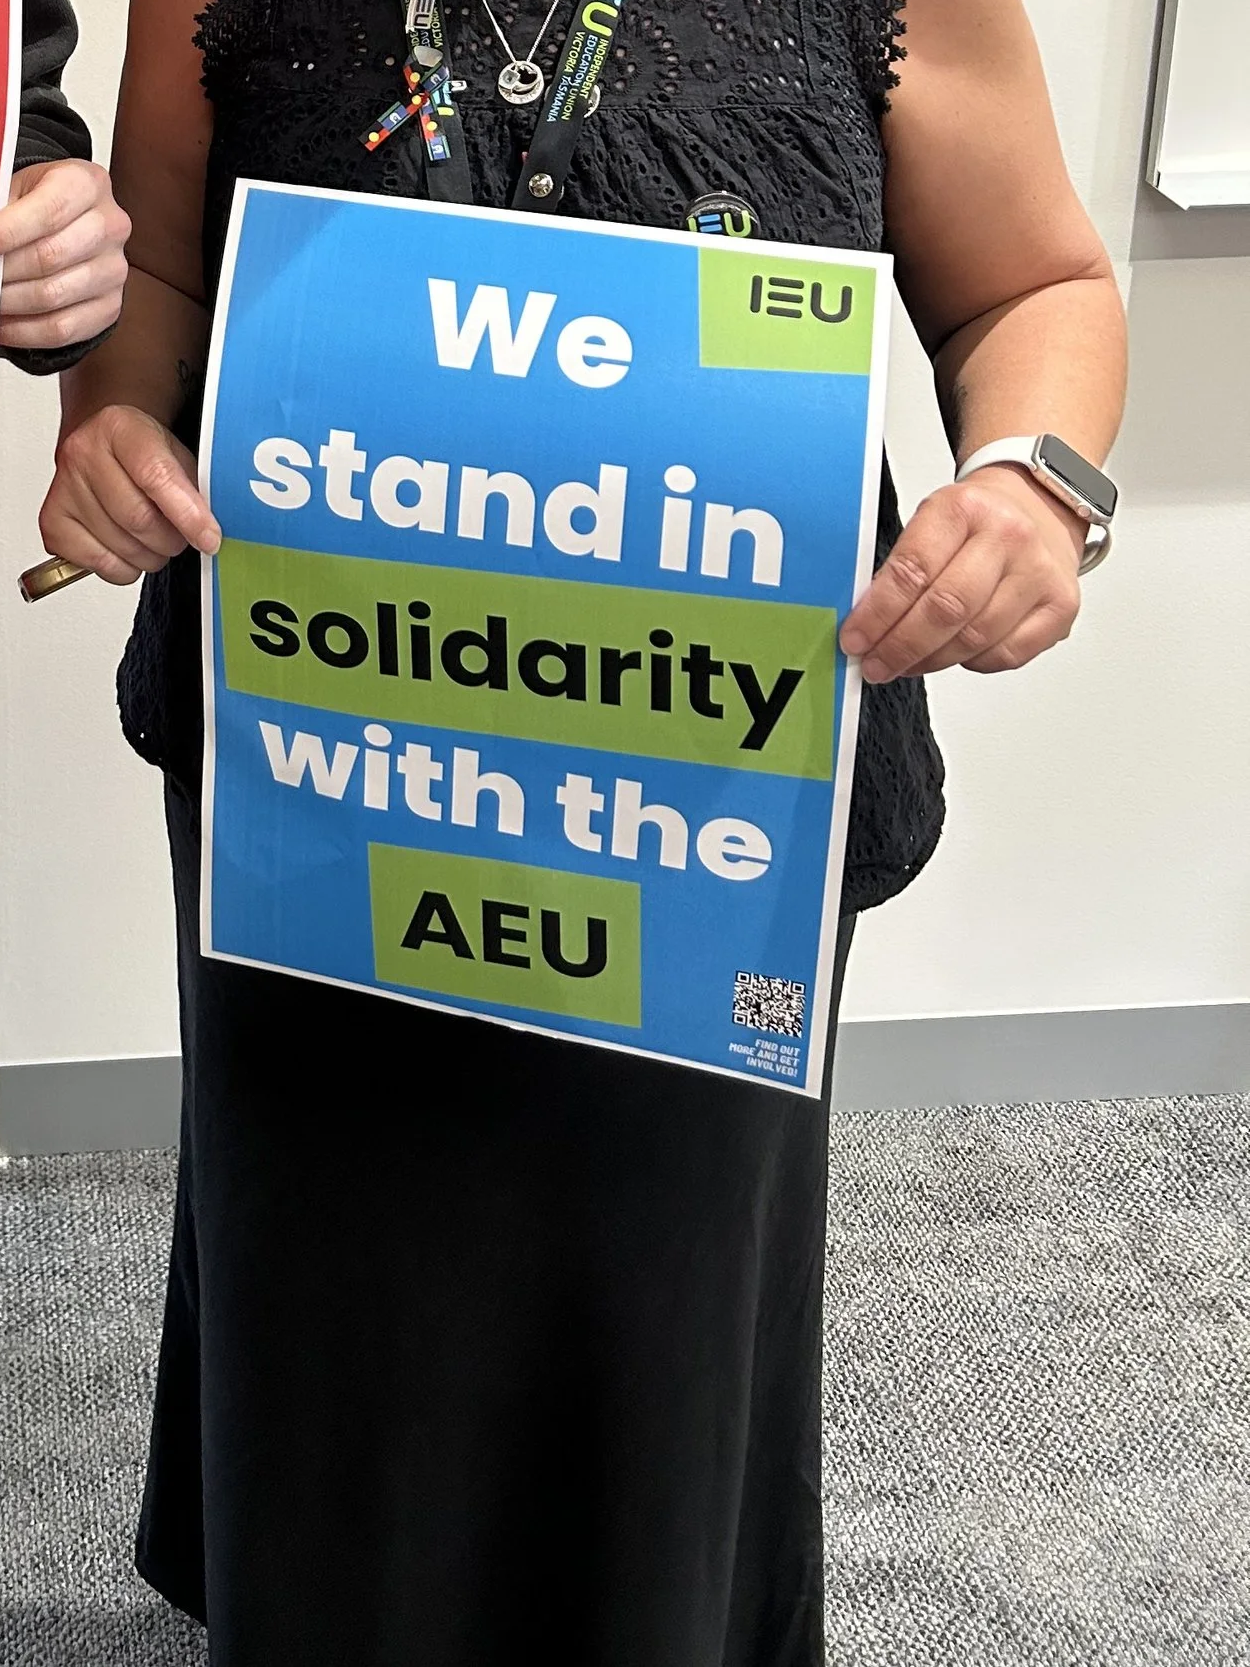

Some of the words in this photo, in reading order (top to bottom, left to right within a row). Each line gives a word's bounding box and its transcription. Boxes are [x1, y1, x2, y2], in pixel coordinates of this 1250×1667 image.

[564, 31, 586, 73] VICTORIA
[573, 35, 598, 86] EDUCATION
[579, 38, 609, 99] INDEPENDENT
[546, 74, 570, 122] TASMANIA
[561, 86, 579, 121] UNION
[749, 274, 854, 323] IEU
[427, 277, 633, 389] We
[249, 429, 628, 563] stand
[659, 465, 785, 588] in
[249, 600, 805, 751] solidarity
[258, 720, 525, 837] with
[556, 772, 773, 881] the
[400, 890, 608, 979] AEU
[729, 1042, 756, 1056] MORE
[757, 1050, 778, 1063] AND
[780, 1055, 800, 1066] GET
[746, 1057, 798, 1077] INVOLVED!
[755, 1038, 779, 1052] FIND
[780, 1044, 800, 1056] OUT
